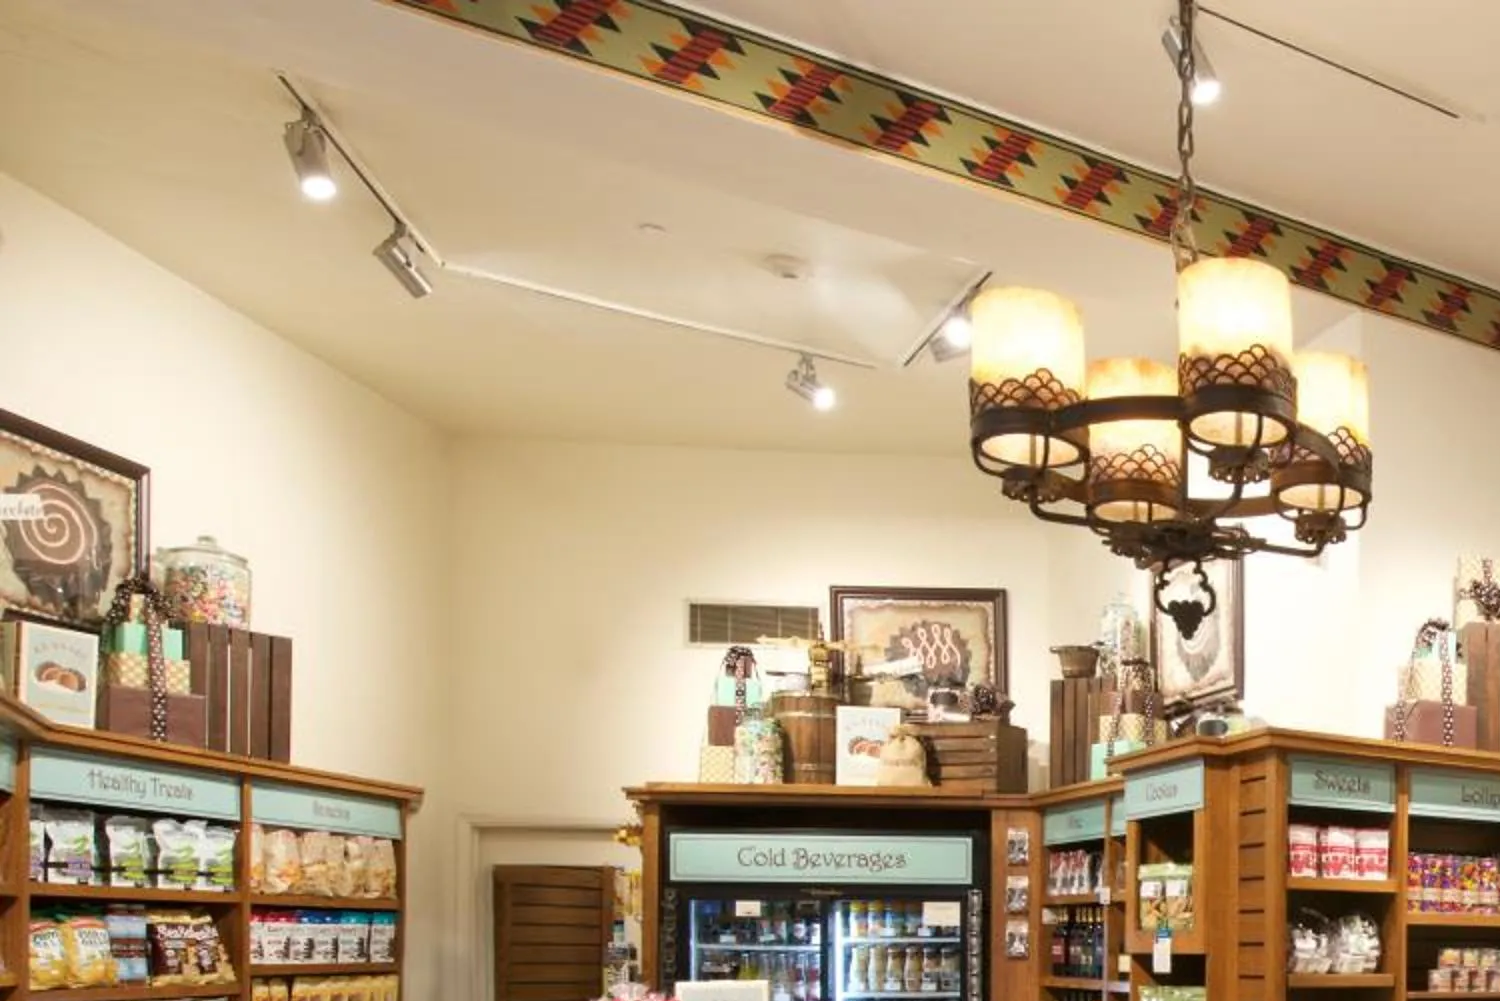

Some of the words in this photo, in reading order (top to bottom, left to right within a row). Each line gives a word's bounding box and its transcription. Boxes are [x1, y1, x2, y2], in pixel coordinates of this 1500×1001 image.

[88, 767, 147, 799] Healthy
[150, 775, 195, 801] Treats
[1313, 769, 1371, 795] Sweets
[737, 847, 786, 868] Cold
[792, 847, 907, 872] Beverages
